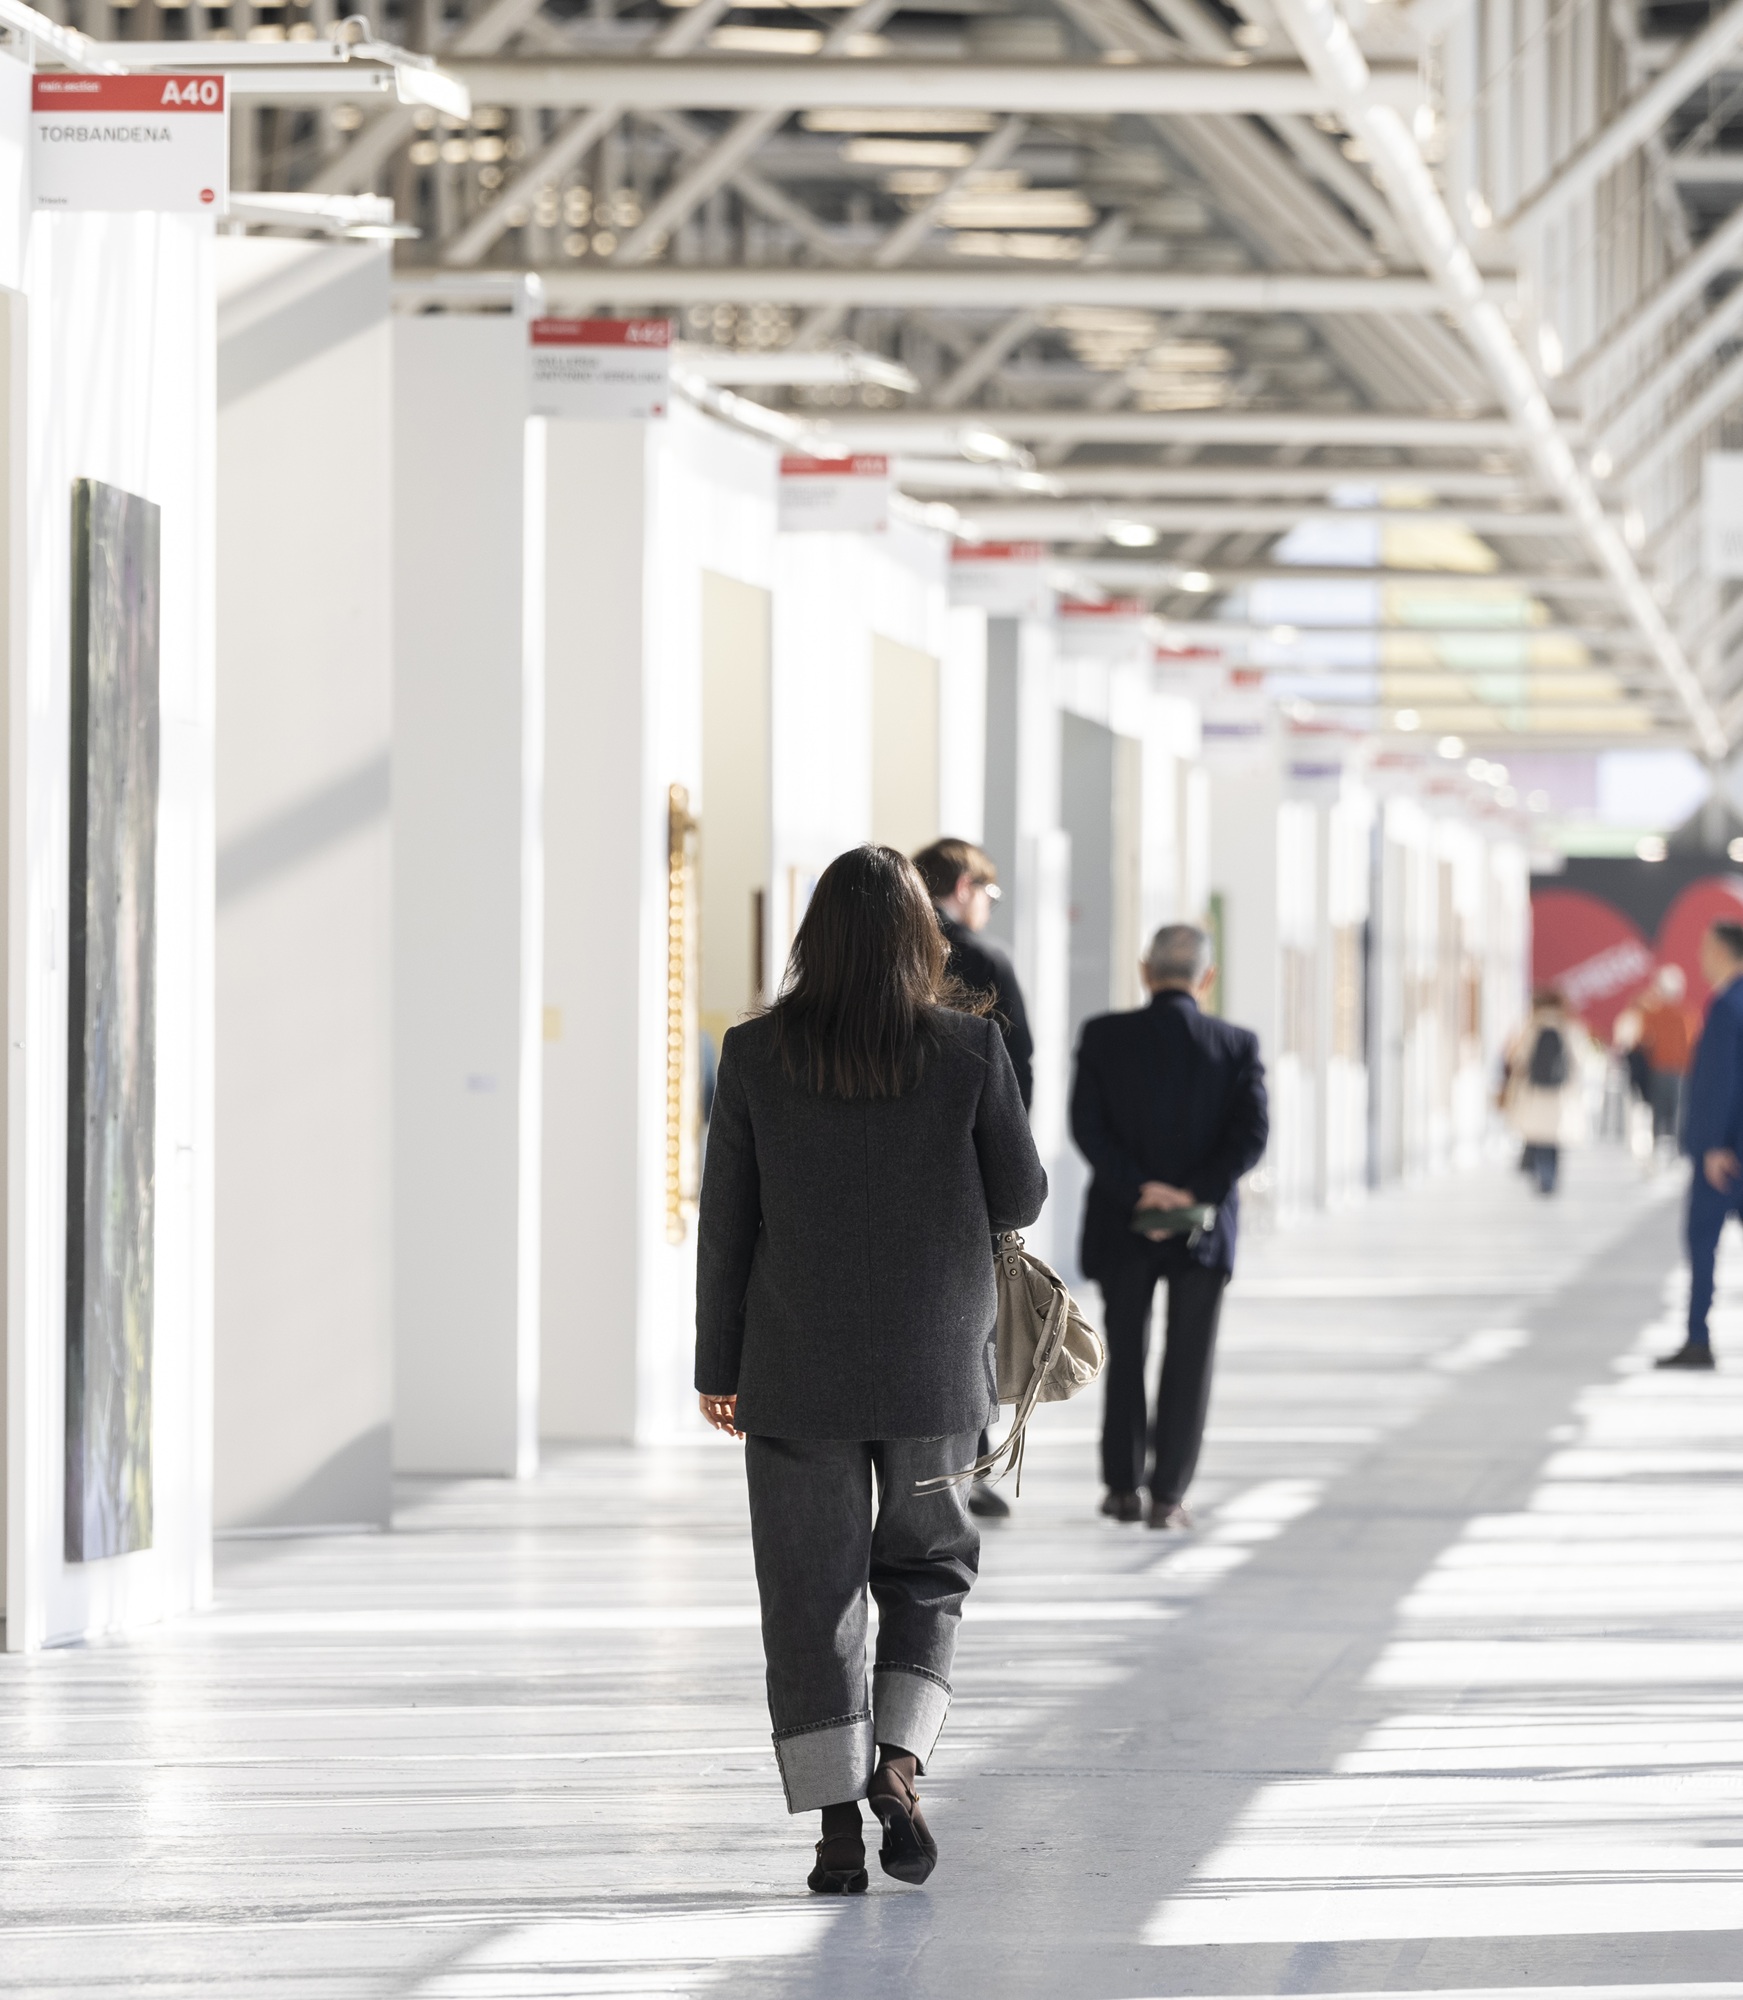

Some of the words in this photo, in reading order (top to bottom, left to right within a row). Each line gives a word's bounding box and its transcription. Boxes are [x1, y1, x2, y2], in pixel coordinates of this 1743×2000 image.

[64, 80, 100, 92] section
[160, 79, 219, 106] A40
[39, 126, 172, 143] TORBANDENA
